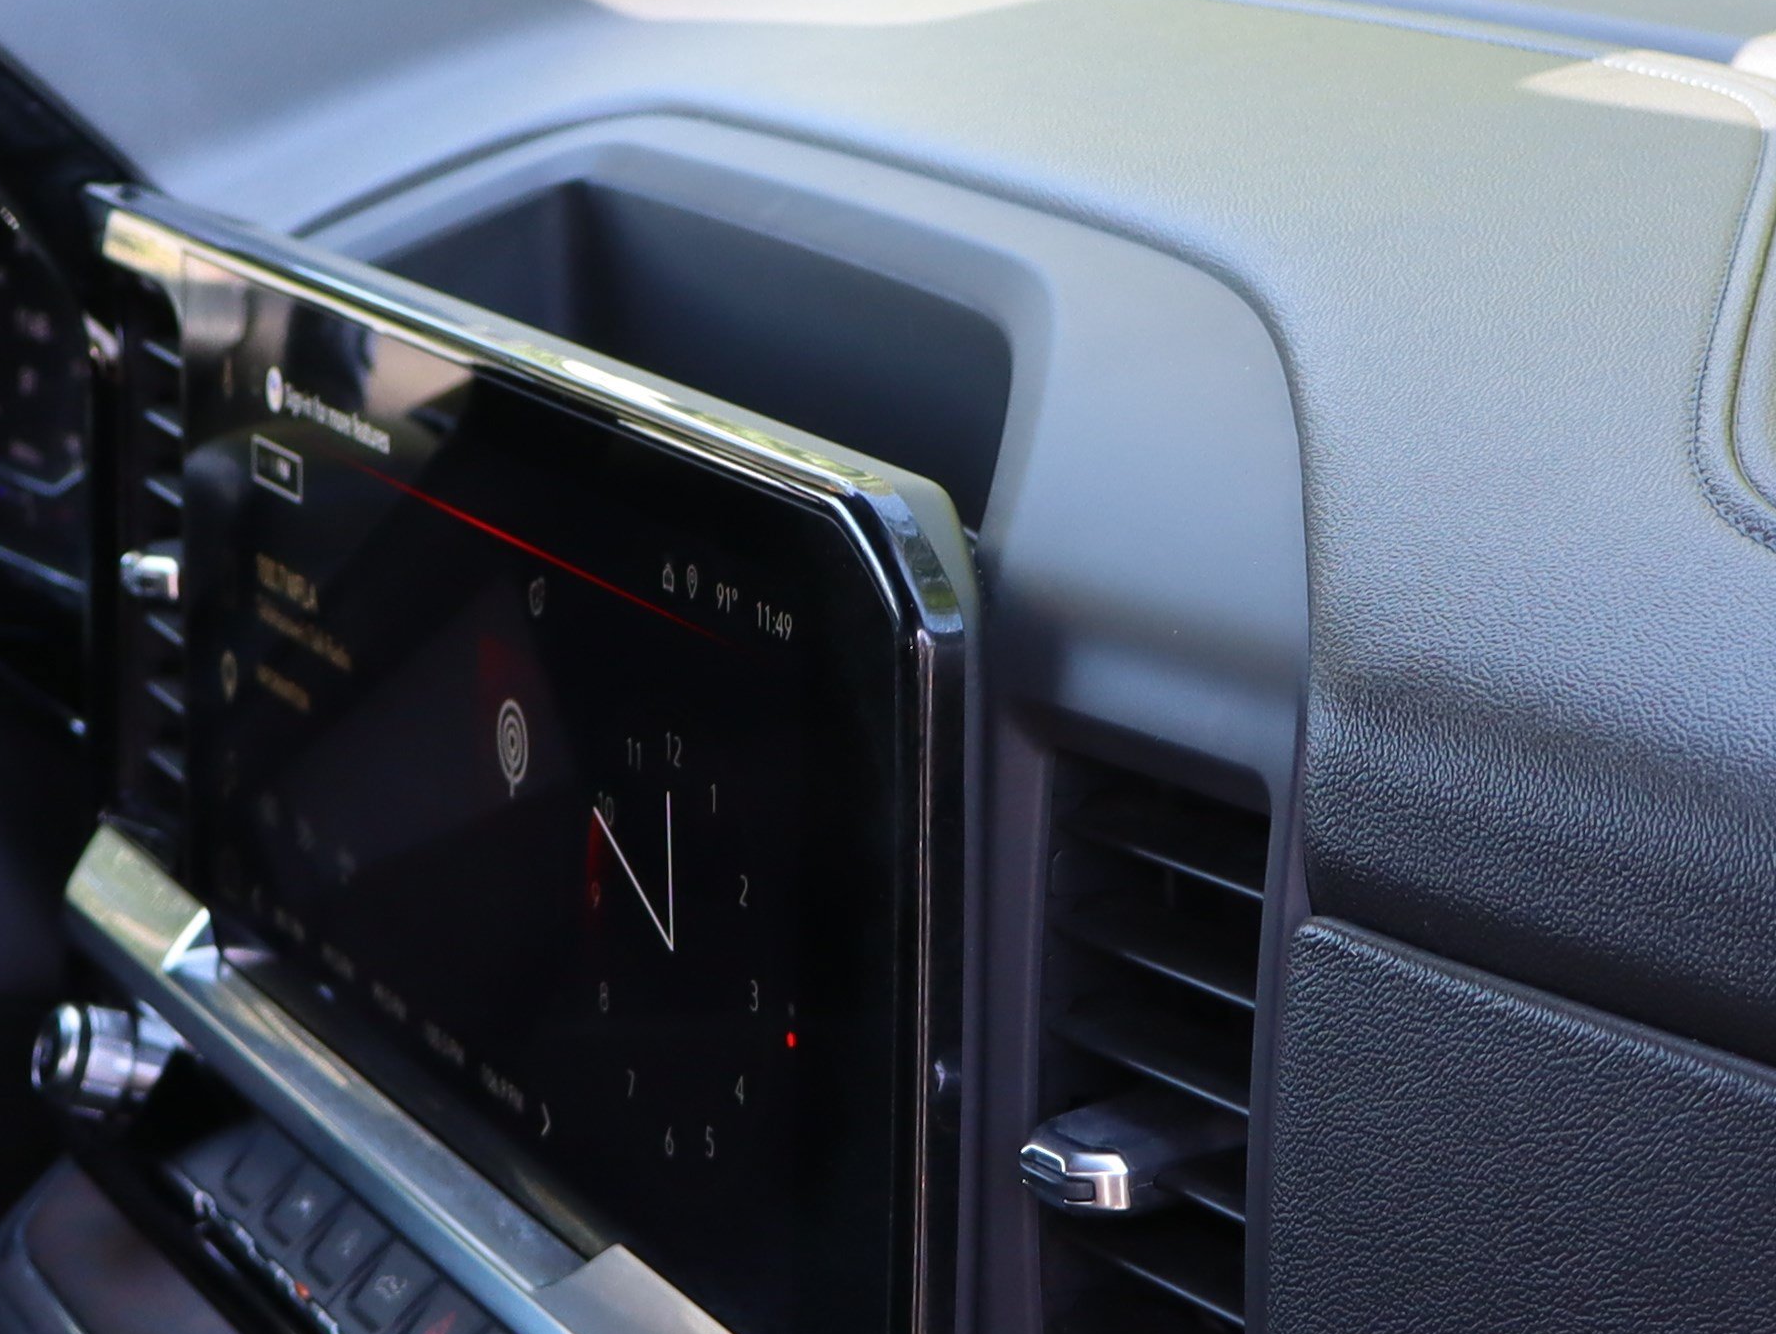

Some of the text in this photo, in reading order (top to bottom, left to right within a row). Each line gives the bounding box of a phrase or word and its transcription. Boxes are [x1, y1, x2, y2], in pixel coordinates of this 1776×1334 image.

[756, 600, 793, 641] 11:49
[626, 736, 642, 770] 11
[666, 731, 682, 768] 12
[597, 791, 614, 826] 10
[710, 783, 717, 813] 1
[590, 881, 601, 908] 9
[738, 874, 749, 907] 2
[598, 981, 609, 1012] 8
[749, 979, 759, 1011] 3
[626, 1068, 636, 1098] 7
[735, 1075, 745, 1105] 4
[664, 1126, 674, 1156] 6
[705, 1125, 715, 1158] 5
